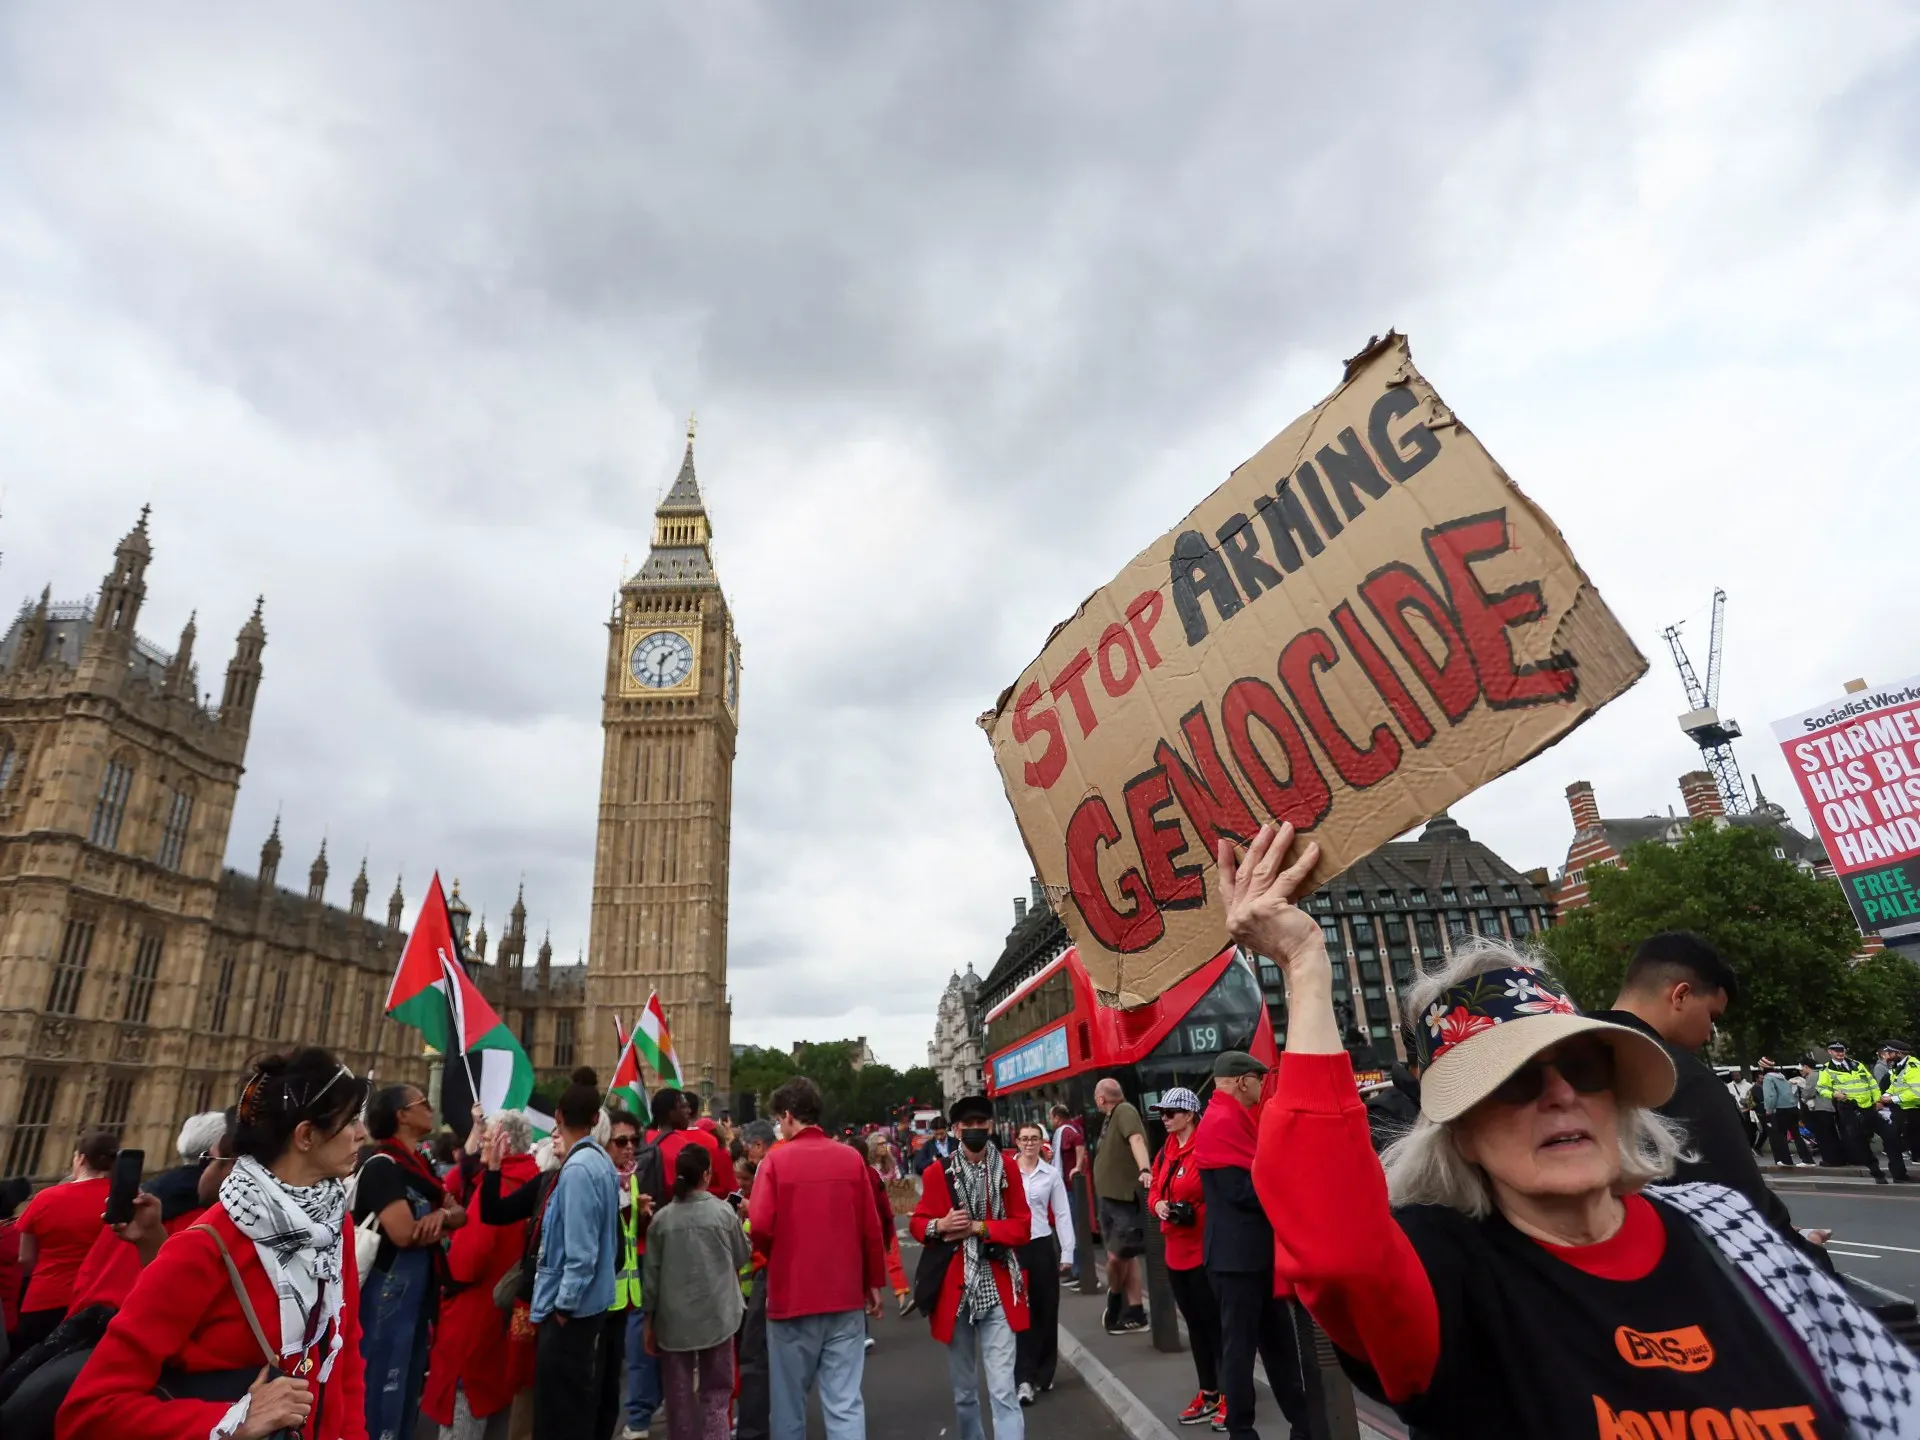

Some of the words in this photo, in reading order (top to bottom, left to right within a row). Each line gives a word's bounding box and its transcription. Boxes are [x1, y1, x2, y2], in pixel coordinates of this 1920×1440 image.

[1011, 589, 1164, 789] STOP
[1170, 387, 1443, 646] ARMING
[1065, 506, 1580, 953] GENOCIDE
[1803, 698, 1873, 732] Socialist
[1806, 761, 1873, 803] HAS
[1823, 795, 1873, 833] ON
[1834, 814, 1920, 867] HAND
[1852, 867, 1912, 899] FREE
[1862, 888, 1920, 923] PALE
[1190, 1026, 1217, 1050] 159
[1622, 1330, 1688, 1366] BDS
